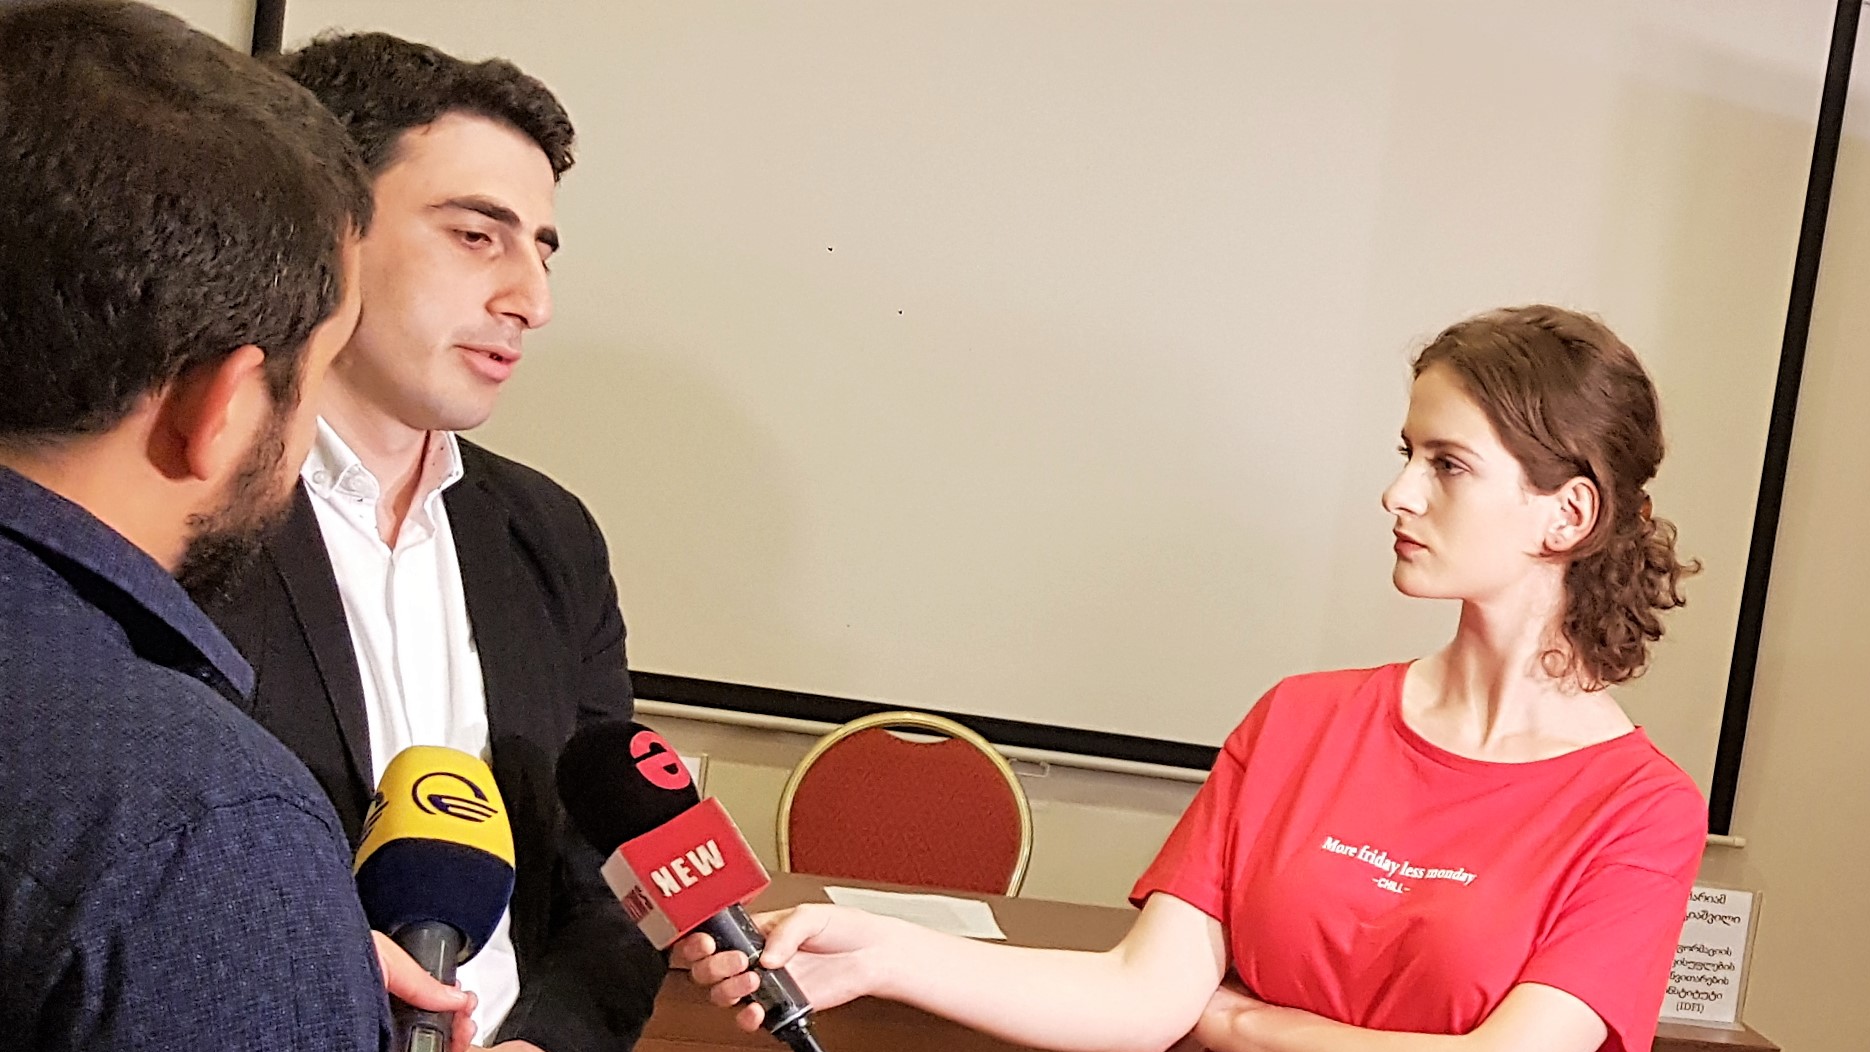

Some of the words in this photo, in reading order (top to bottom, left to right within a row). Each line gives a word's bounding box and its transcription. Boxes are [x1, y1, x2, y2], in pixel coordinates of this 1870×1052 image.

[1321, 836, 1358, 857] More
[1357, 845, 1400, 877] friday
[1400, 861, 1425, 879] less
[1425, 867, 1478, 886] monday
[1690, 891, 1727, 904] არიამ
[1684, 910, 1742, 926] იაშვილი
